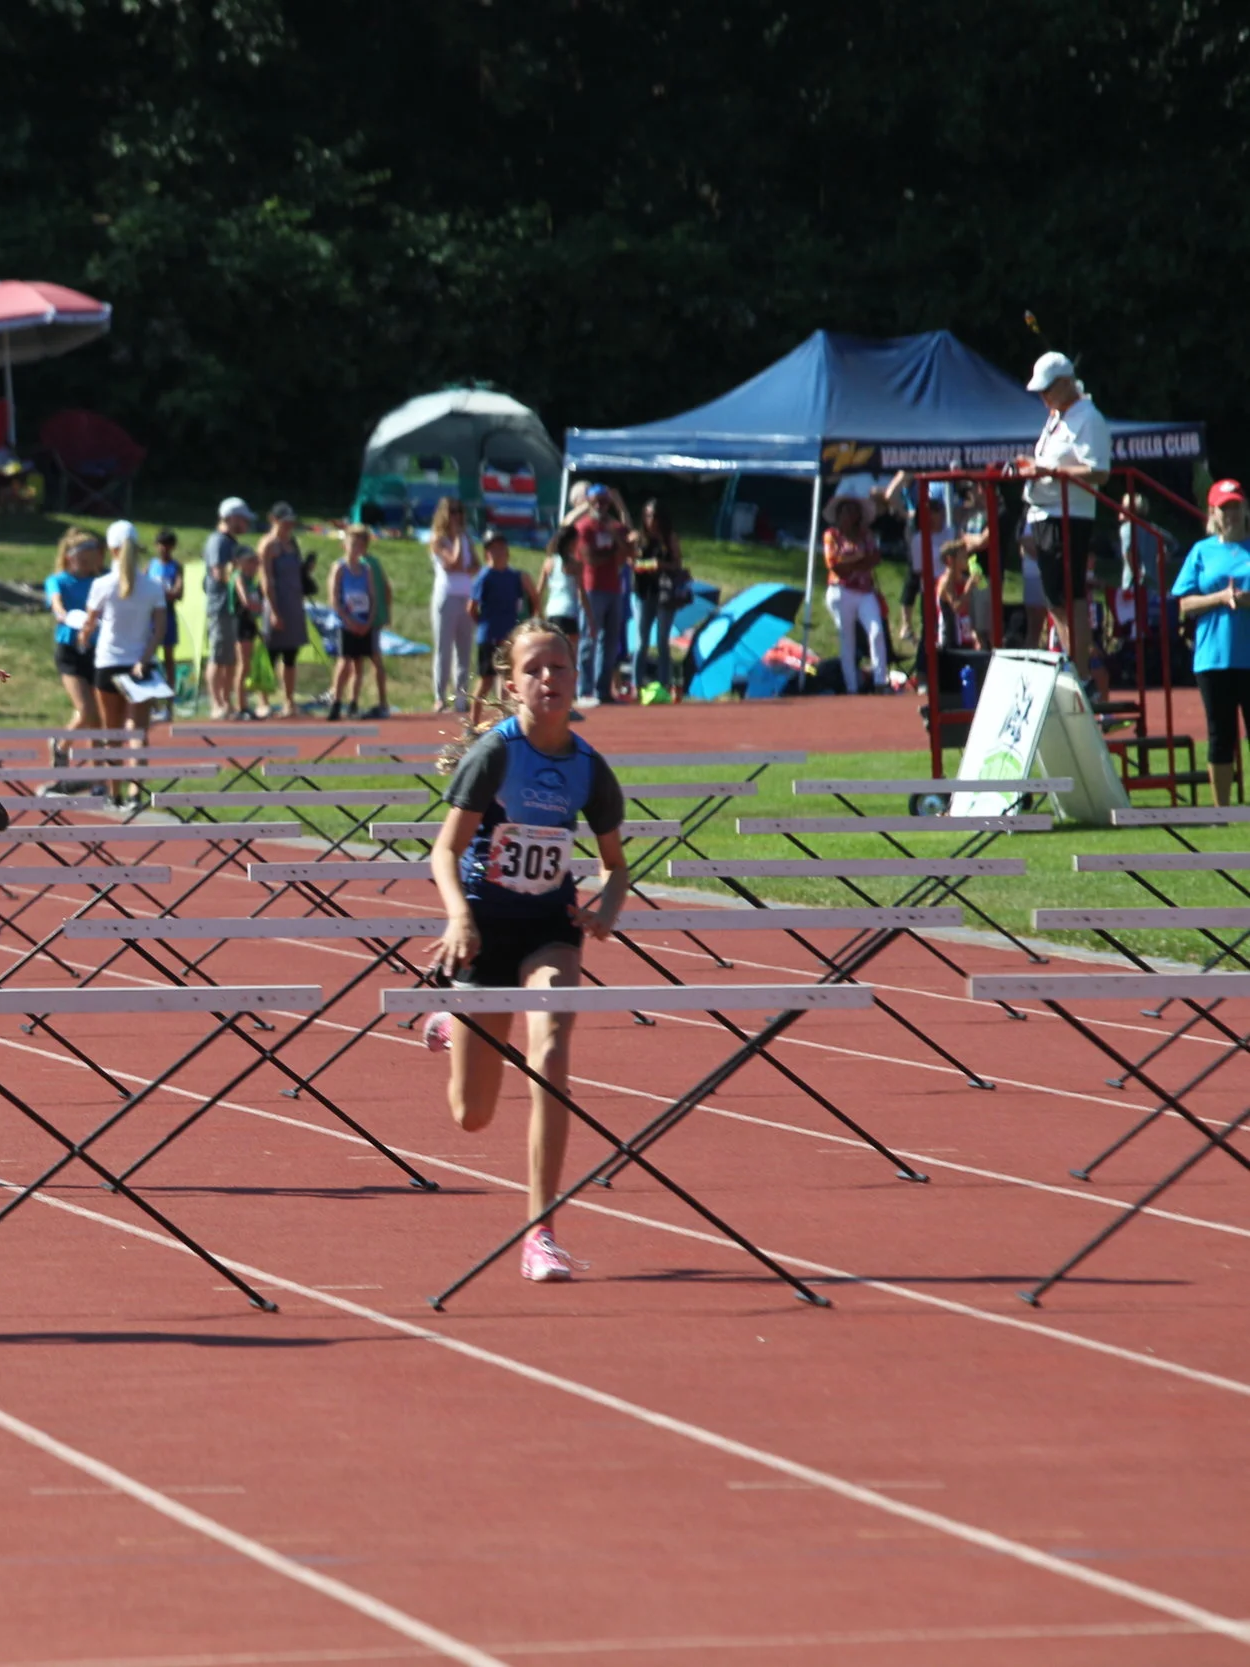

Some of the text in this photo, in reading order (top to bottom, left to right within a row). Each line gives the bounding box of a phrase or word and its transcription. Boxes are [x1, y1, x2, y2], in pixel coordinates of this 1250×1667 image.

[881, 446, 961, 468] VANCOUVER
[1129, 435, 1163, 458] FIELD
[1165, 432, 1200, 456] CLUB
[501, 841, 561, 880] 303
